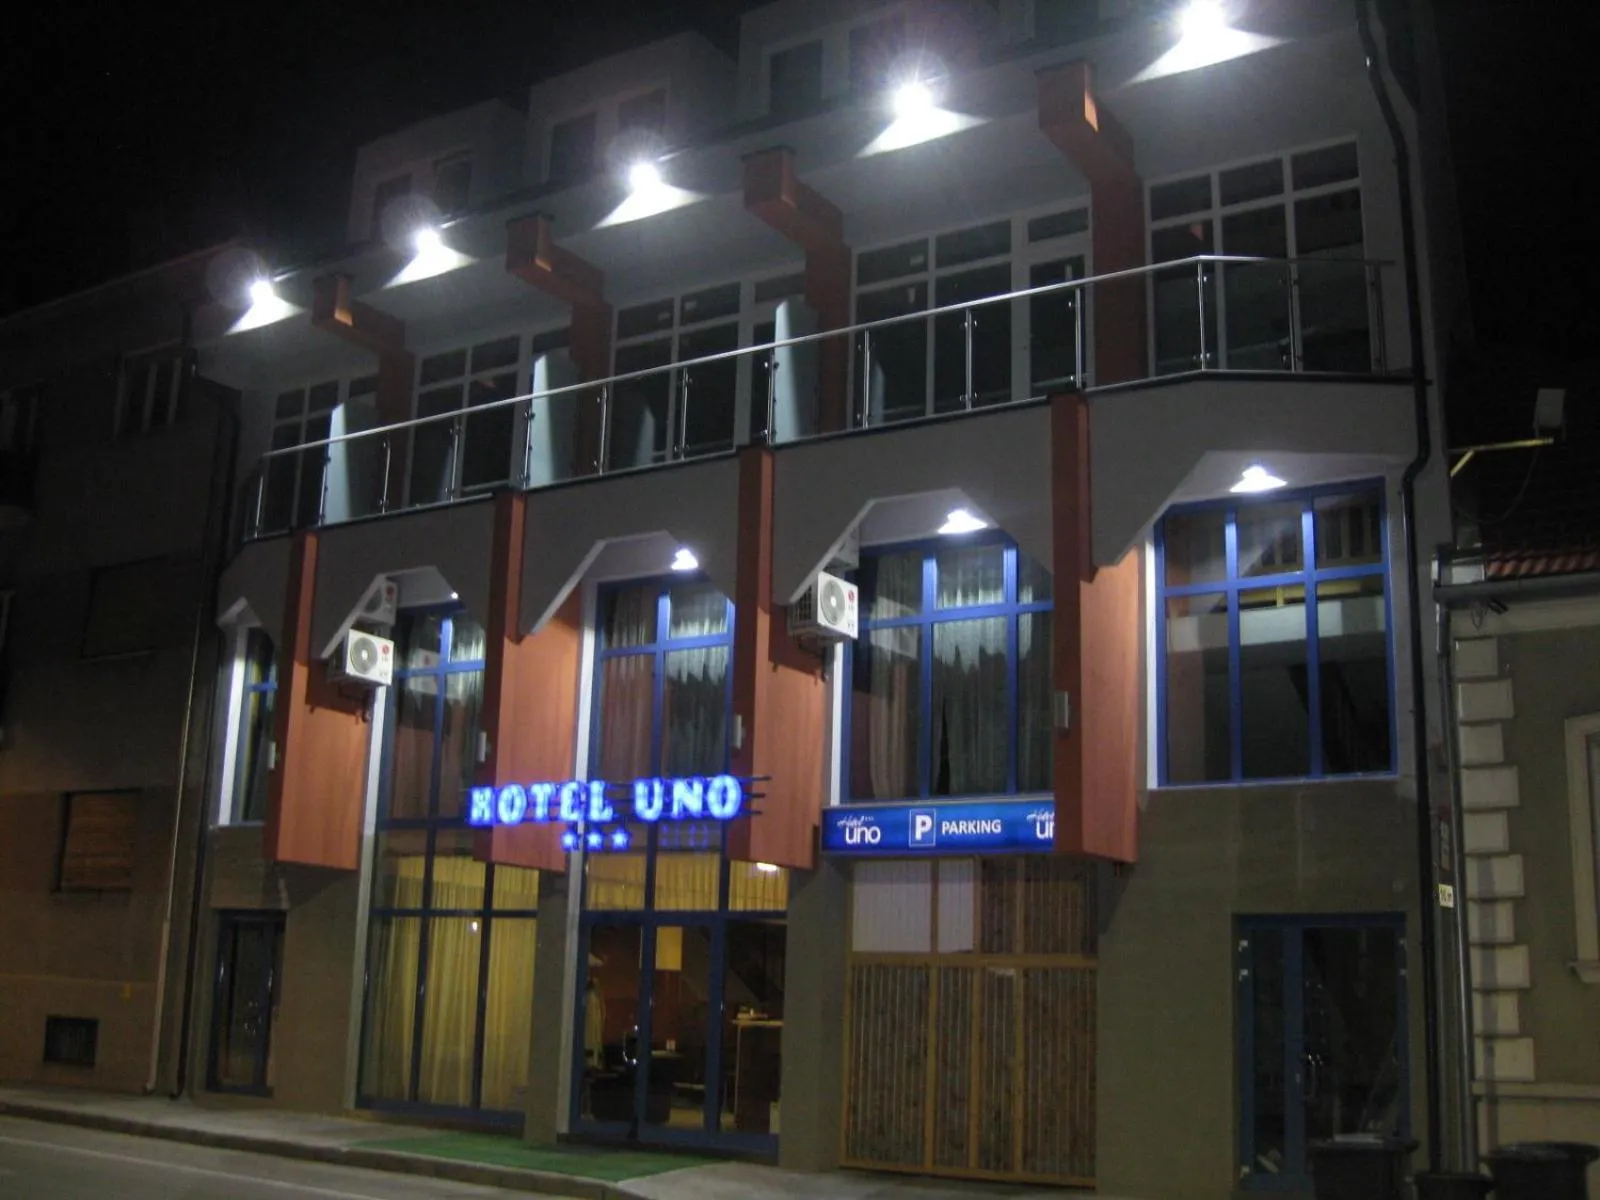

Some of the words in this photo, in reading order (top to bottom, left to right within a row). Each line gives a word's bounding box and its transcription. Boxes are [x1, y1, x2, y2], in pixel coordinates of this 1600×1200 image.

[470, 780, 612, 825] HOTEL
[635, 776, 741, 820] UNO
[845, 826, 881, 845] uno
[914, 815, 932, 841] P
[941, 818, 1002, 836] PARKING
